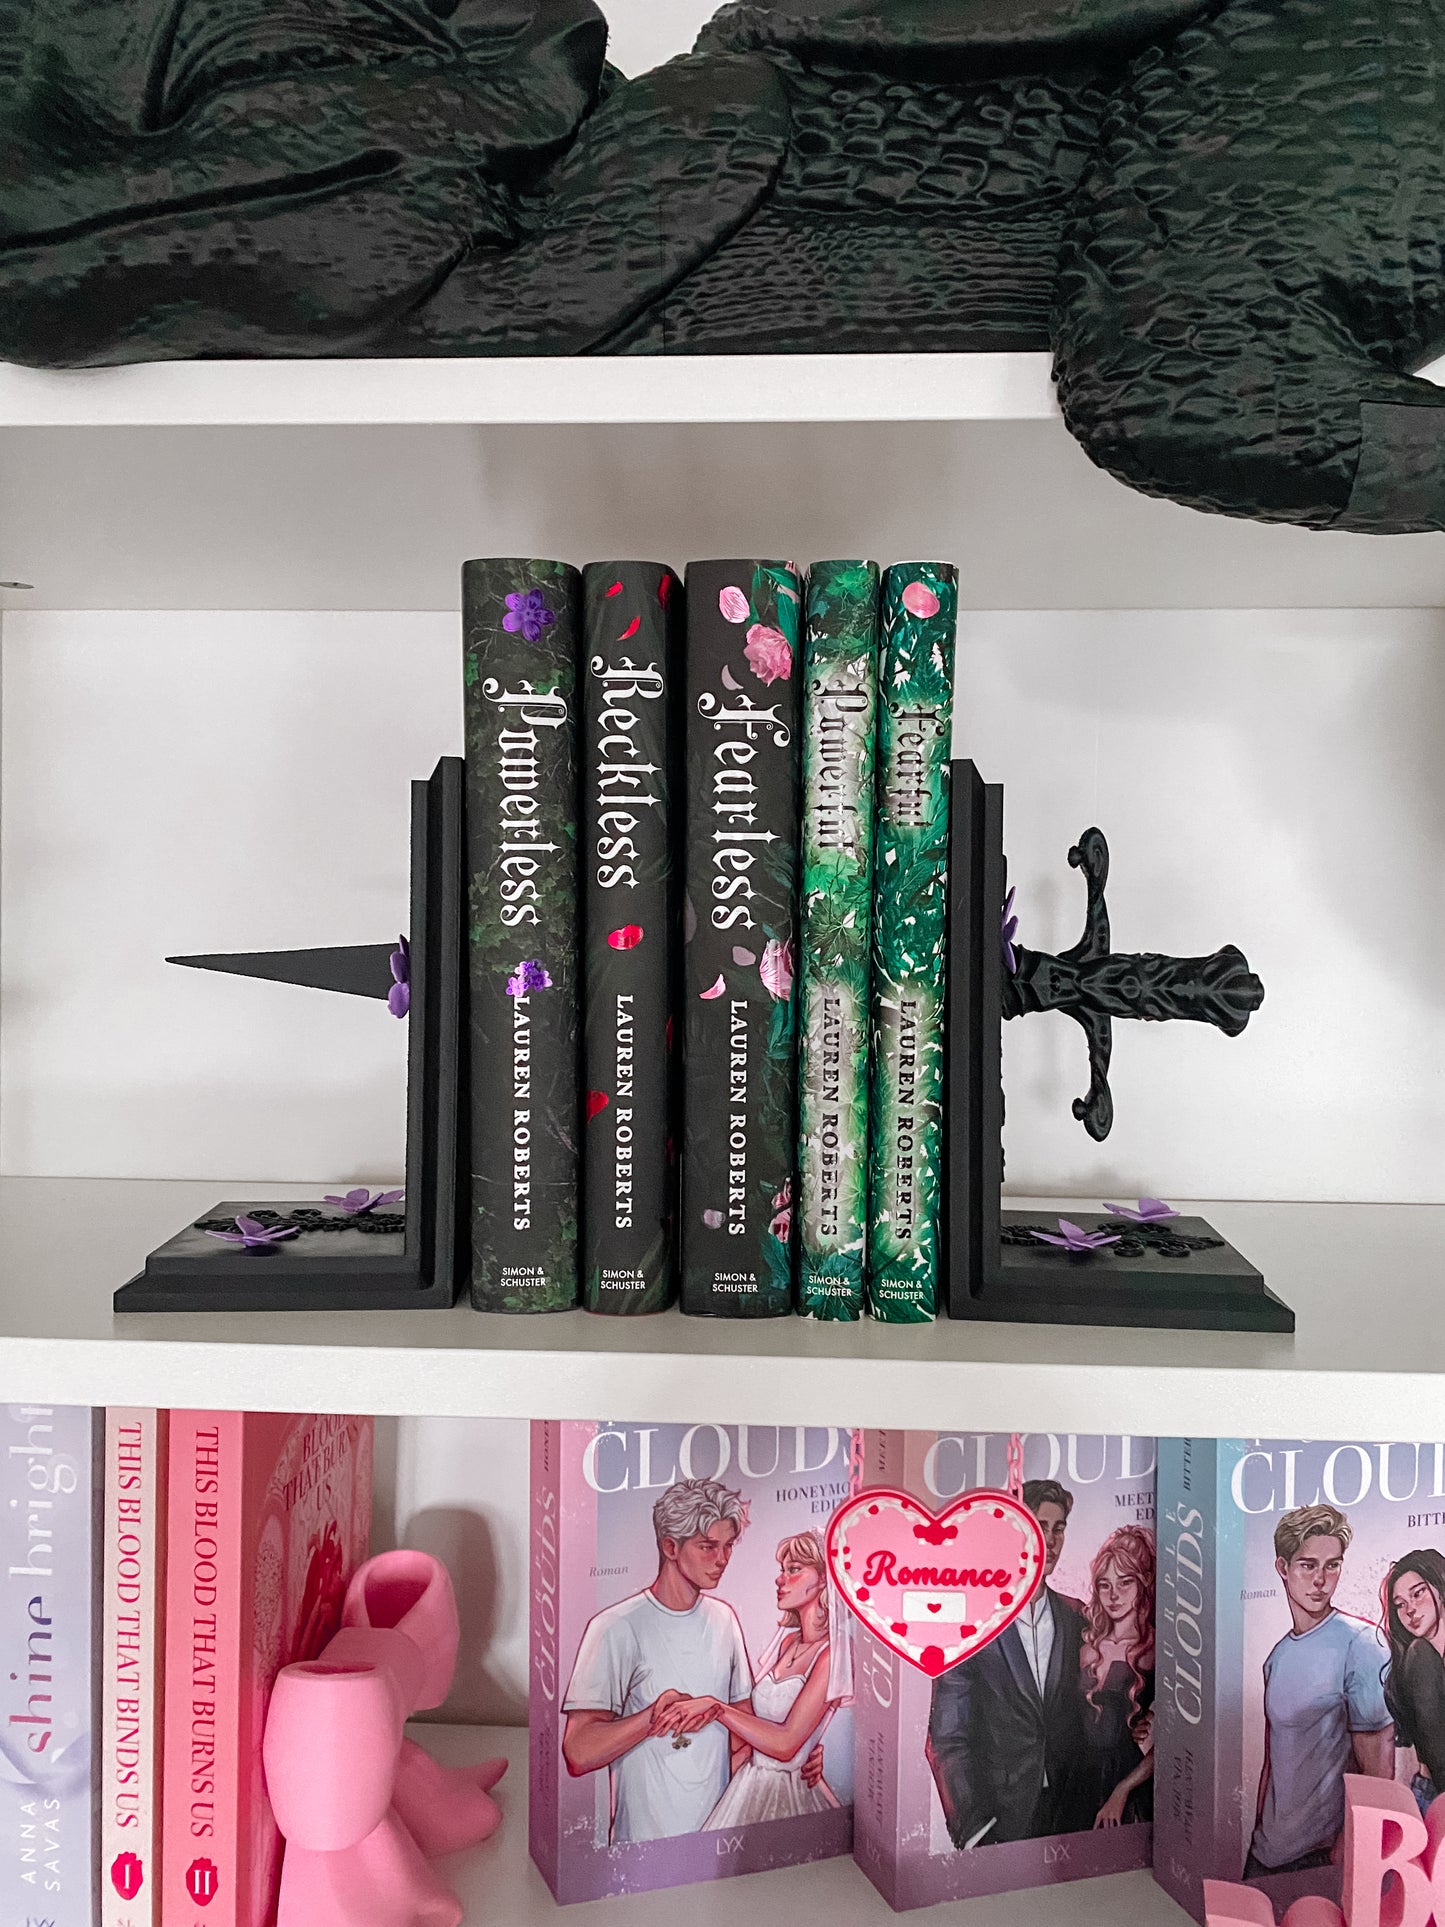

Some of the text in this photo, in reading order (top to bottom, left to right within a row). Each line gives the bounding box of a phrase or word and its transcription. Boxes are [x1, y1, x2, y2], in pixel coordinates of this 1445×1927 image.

[482, 676, 569, 927] Powerless
[590, 654, 665, 890] Reckless
[811, 679, 869, 848] Powerful
[889, 701, 945, 827] Fearful
[697, 691, 791, 931] Fearless
[513, 996, 531, 1232] LAUREN ROBERTS
[614, 993, 634, 1230] LAUREN ROBERTS
[728, 999, 749, 1236] LAUREN ROBERTS
[821, 998, 840, 1236] LAUREN ROBERTS
[895, 1000, 917, 1239] LAUREN ROBERTS
[500, 1277, 546, 1287] SCHUSTER
[502, 1266, 544, 1277] SIMON &
[600, 1280, 646, 1290] SCHUSTER
[602, 1269, 644, 1279] SIMON &
[712, 1283, 759, 1293] SCHUSTER
[714, 1272, 757, 1282] SIMON &
[806, 1286, 852, 1297] SCHUSTER
[808, 1275, 850, 1286] SIMON &
[878, 1289, 924, 1300] SCHUSTER
[881, 1278, 923, 1289] SIMON &
[541, 1491, 556, 1701] CLOUDS
[589, 1565, 629, 1577] Roman
[863, 1550, 1012, 1588] Romance
[1175, 1501, 1204, 1725] CLOUDS
[1240, 1587, 1276, 1601] Roman
[115, 1422, 142, 1829] THIS BLOOD THAT BINDS US
[190, 1426, 219, 1838] THIS BLOOD THAT BURNS US
[8, 1595, 53, 1754] shine
[20, 1800, 37, 1885] ANNA
[44, 1798, 61, 1892] SAVAS
[716, 1835, 745, 1856] LYX
[1044, 1843, 1070, 1864] LYX
